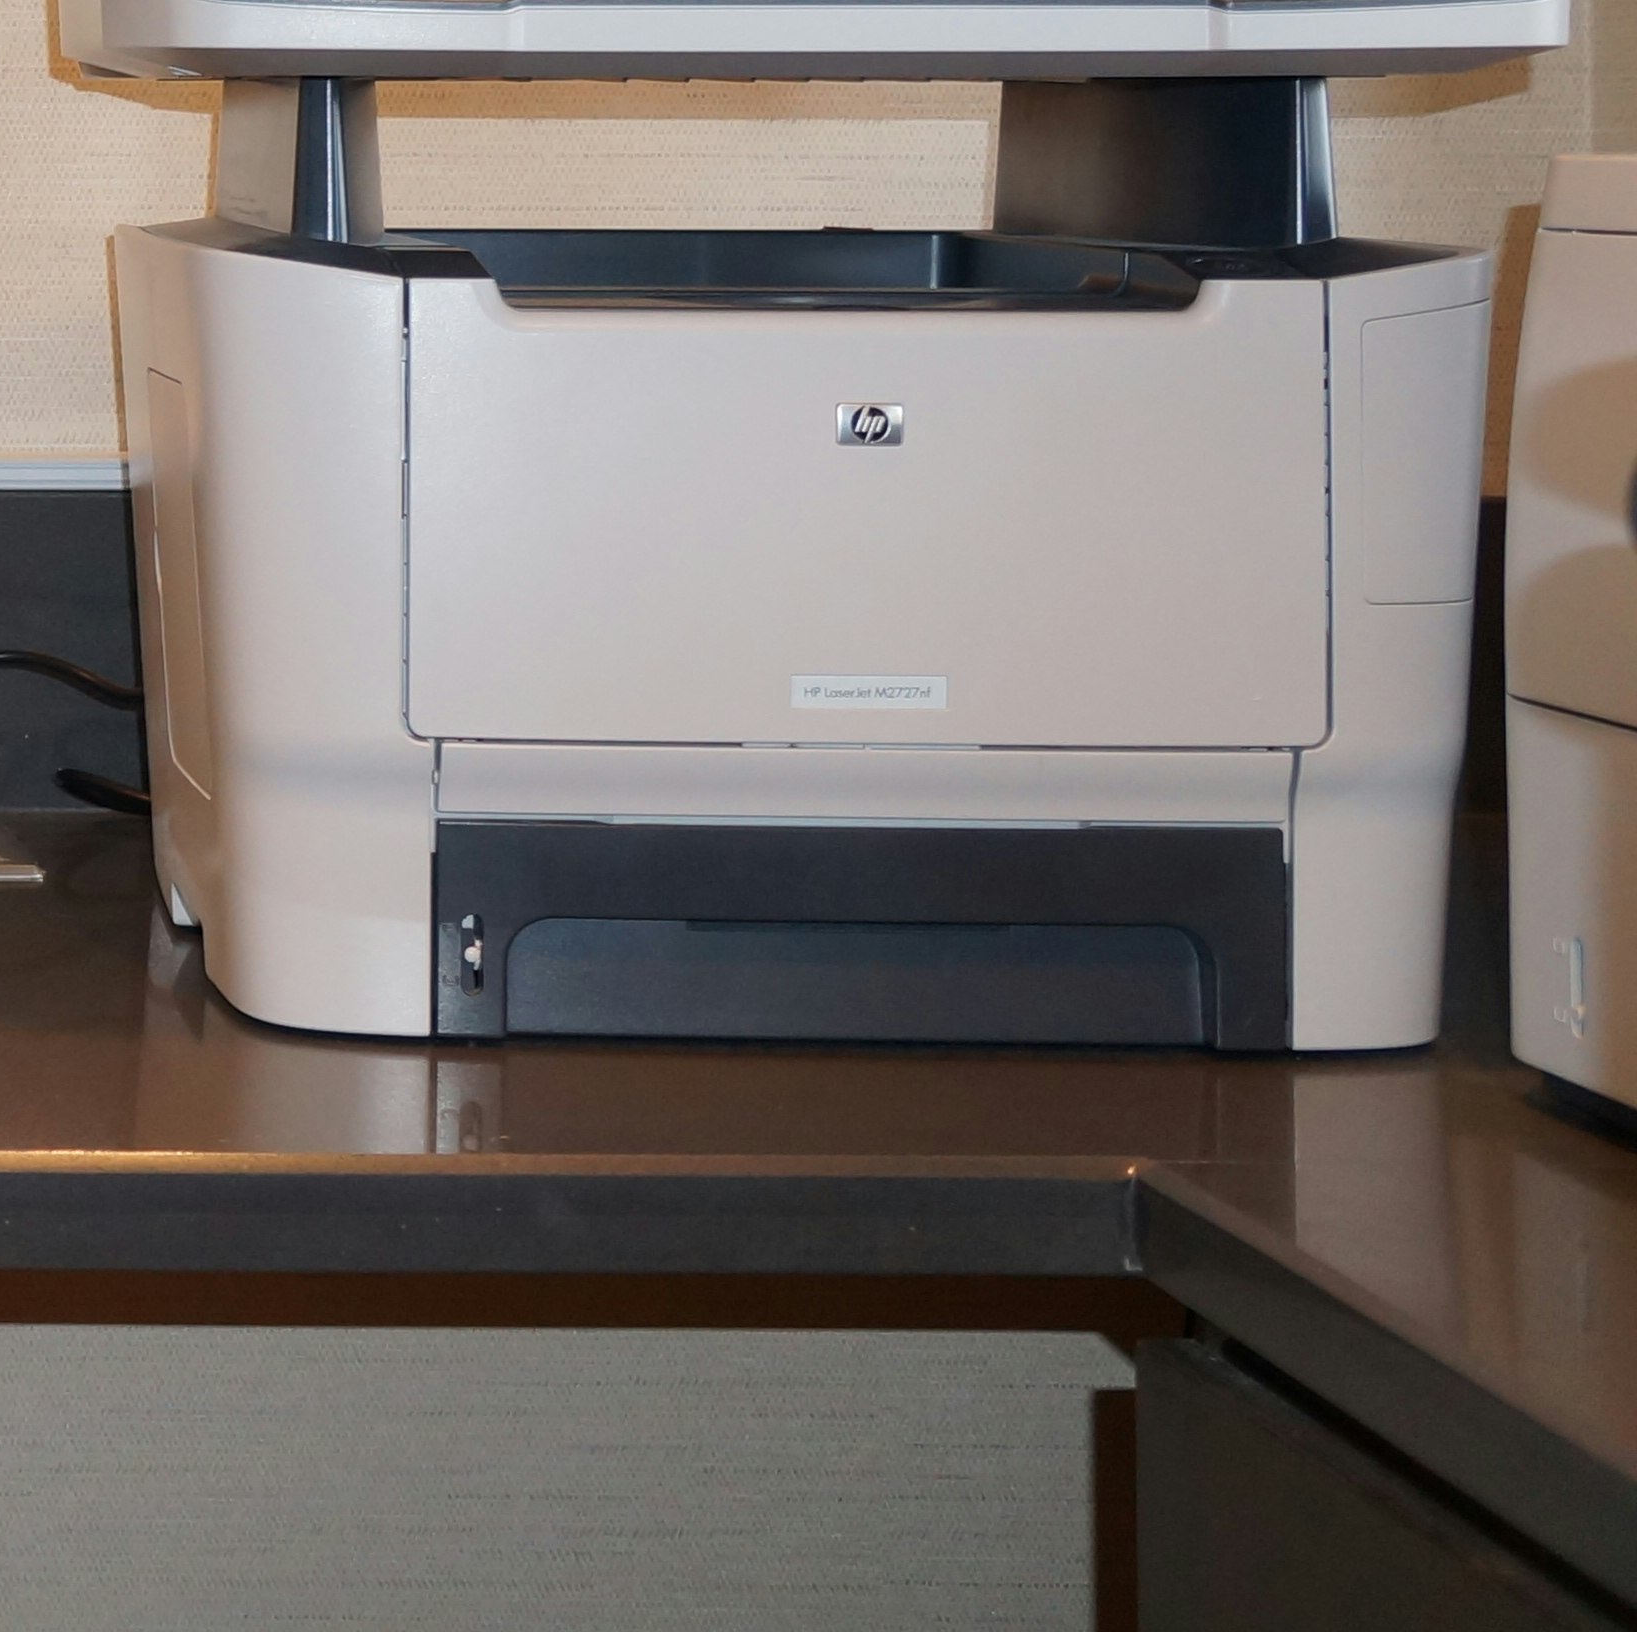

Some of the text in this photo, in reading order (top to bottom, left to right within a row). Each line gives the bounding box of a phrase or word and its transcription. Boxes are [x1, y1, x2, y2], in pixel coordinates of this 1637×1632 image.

[853, 405, 888, 444] hp
[804, 686, 932, 699] HP LaserJet M2727nf
